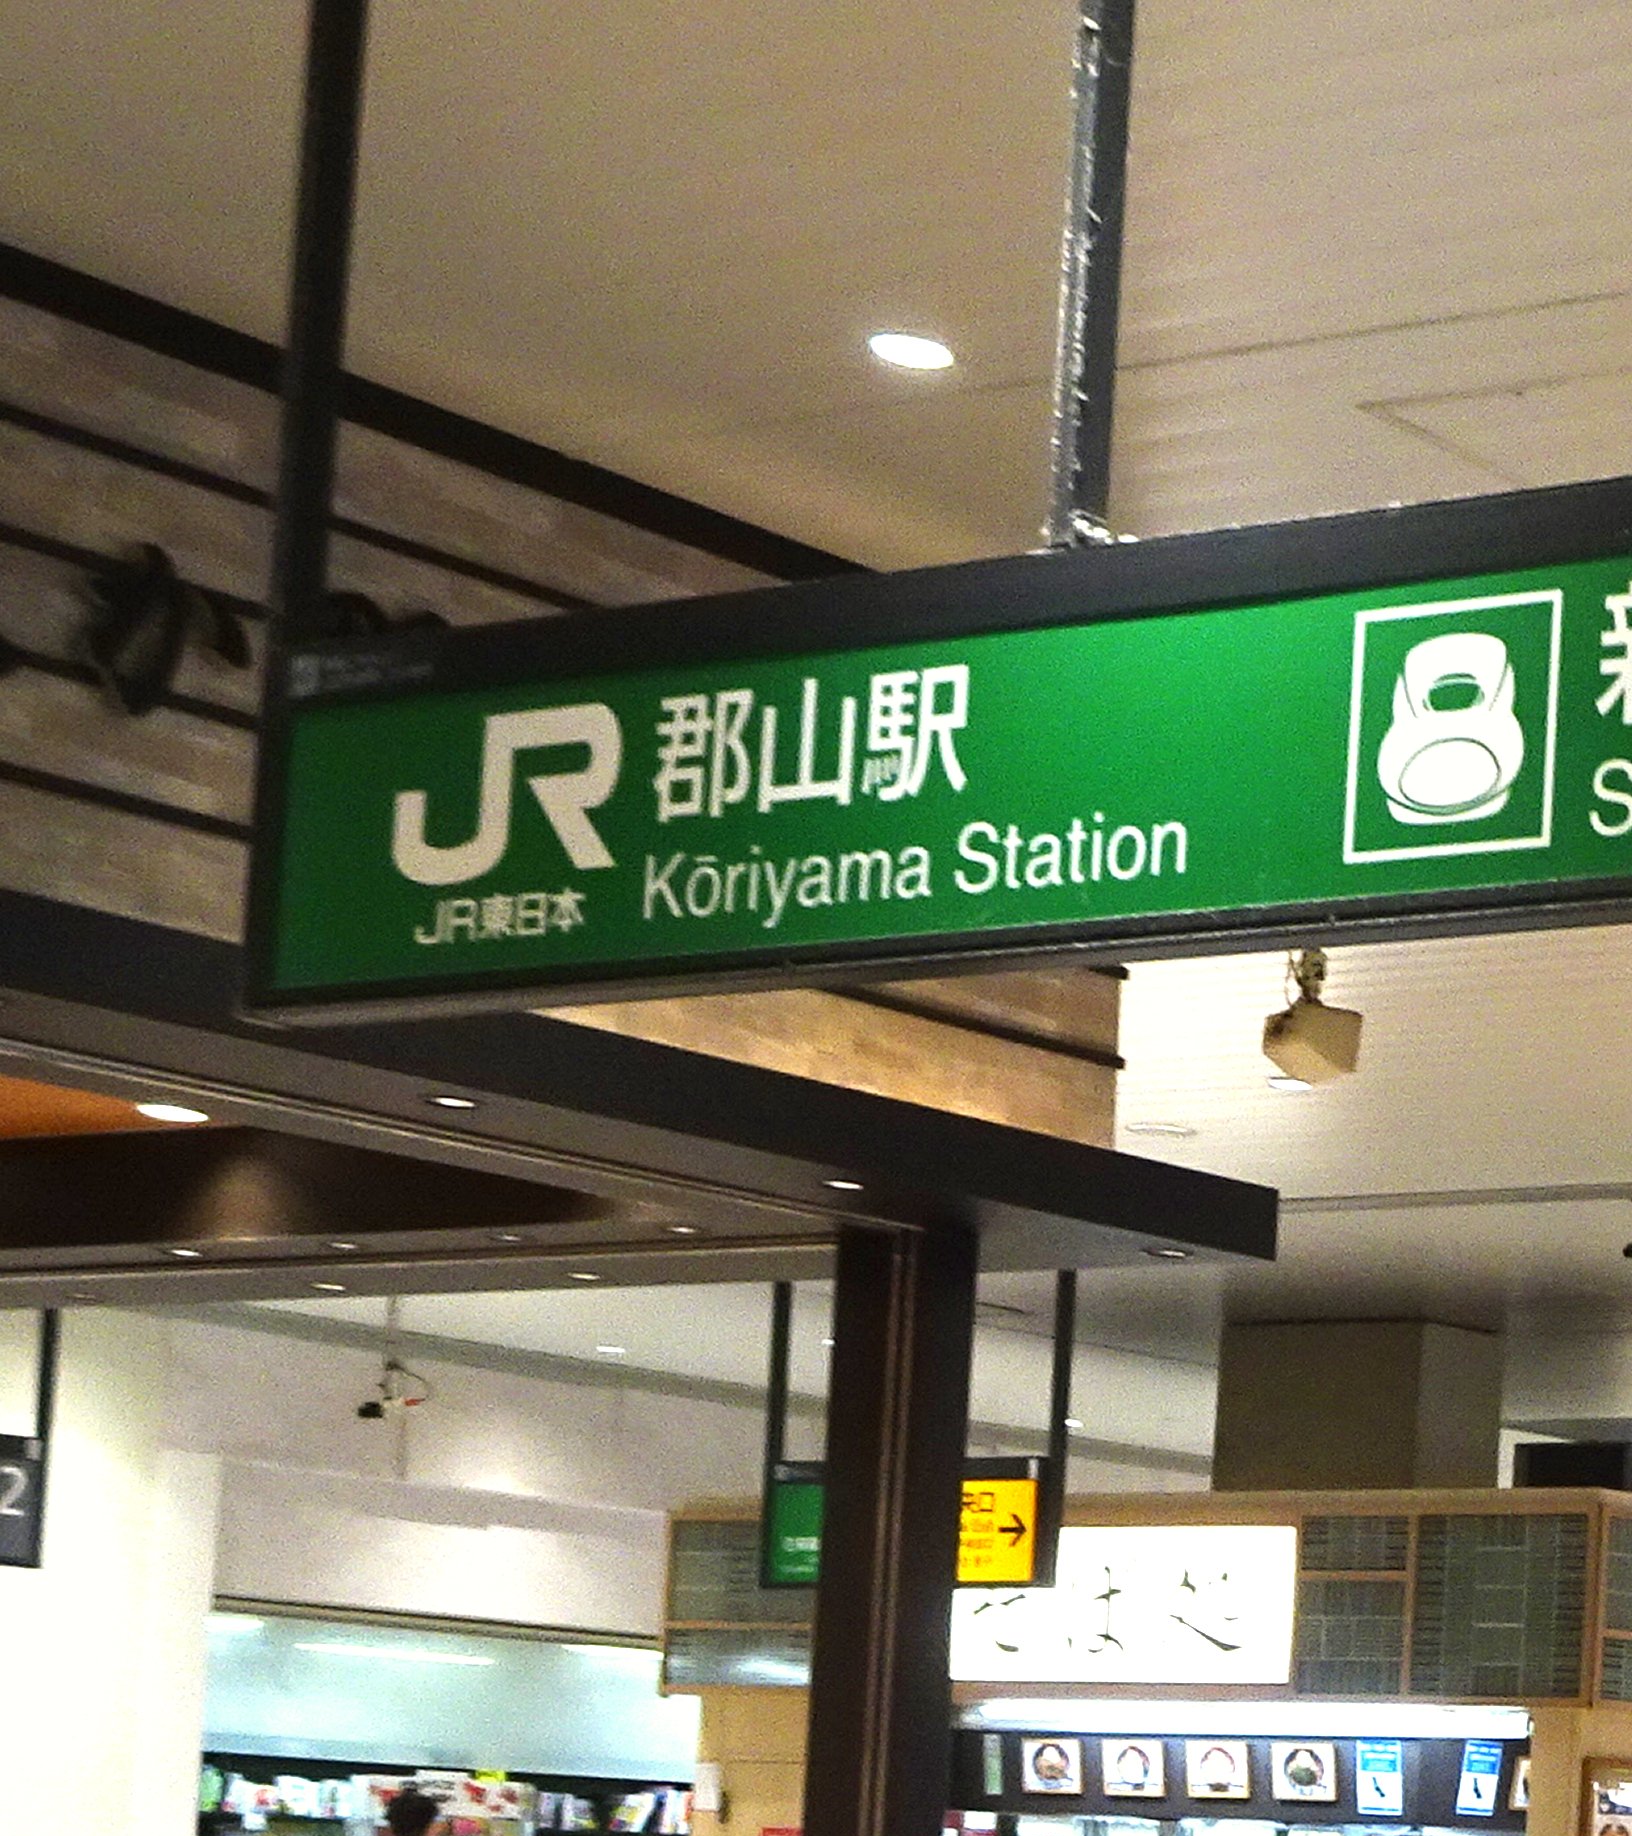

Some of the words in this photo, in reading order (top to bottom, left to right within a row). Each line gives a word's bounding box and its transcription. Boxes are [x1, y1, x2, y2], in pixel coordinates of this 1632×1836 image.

[392, 703, 622, 886] JR
[652, 665, 969, 823] 郡山駅
[414, 887, 584, 946] JR東日本
[641, 843, 932, 928] Kōriyama
[953, 810, 1188, 892] Station
